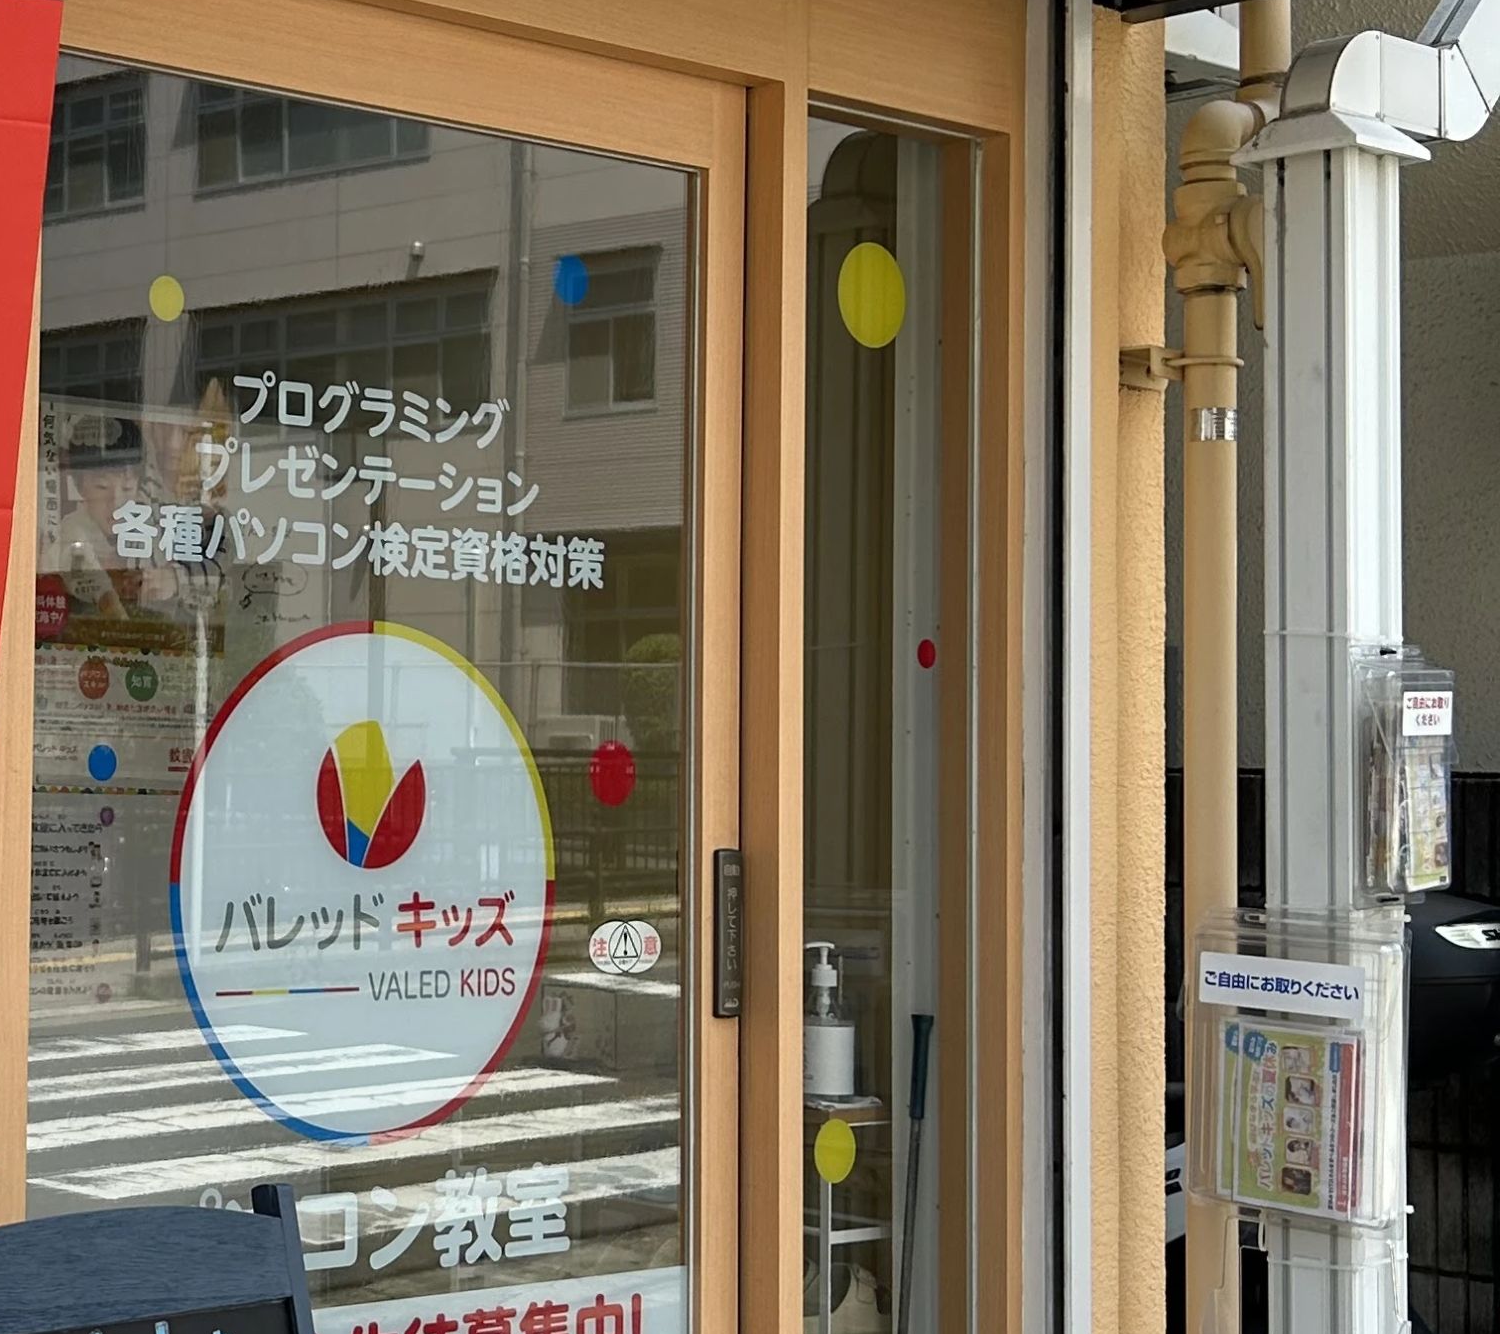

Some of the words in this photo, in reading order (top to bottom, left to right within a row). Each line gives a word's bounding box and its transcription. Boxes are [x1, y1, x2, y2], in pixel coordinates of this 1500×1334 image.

[232, 370, 512, 450] プログラミング
[195, 435, 541, 517] プレゼンテーション
[111, 500, 605, 591] 各種パソコン検定資格対策
[1414, 712, 1441, 727] ください
[214, 892, 386, 953] バレッド
[395, 889, 517, 949] キッズ
[368, 969, 451, 1004] VALED
[458, 967, 517, 997] KIDS
[1204, 970, 1360, 1001] ご自由にお取りください
[192, 1162, 571, 1271] コン教室
